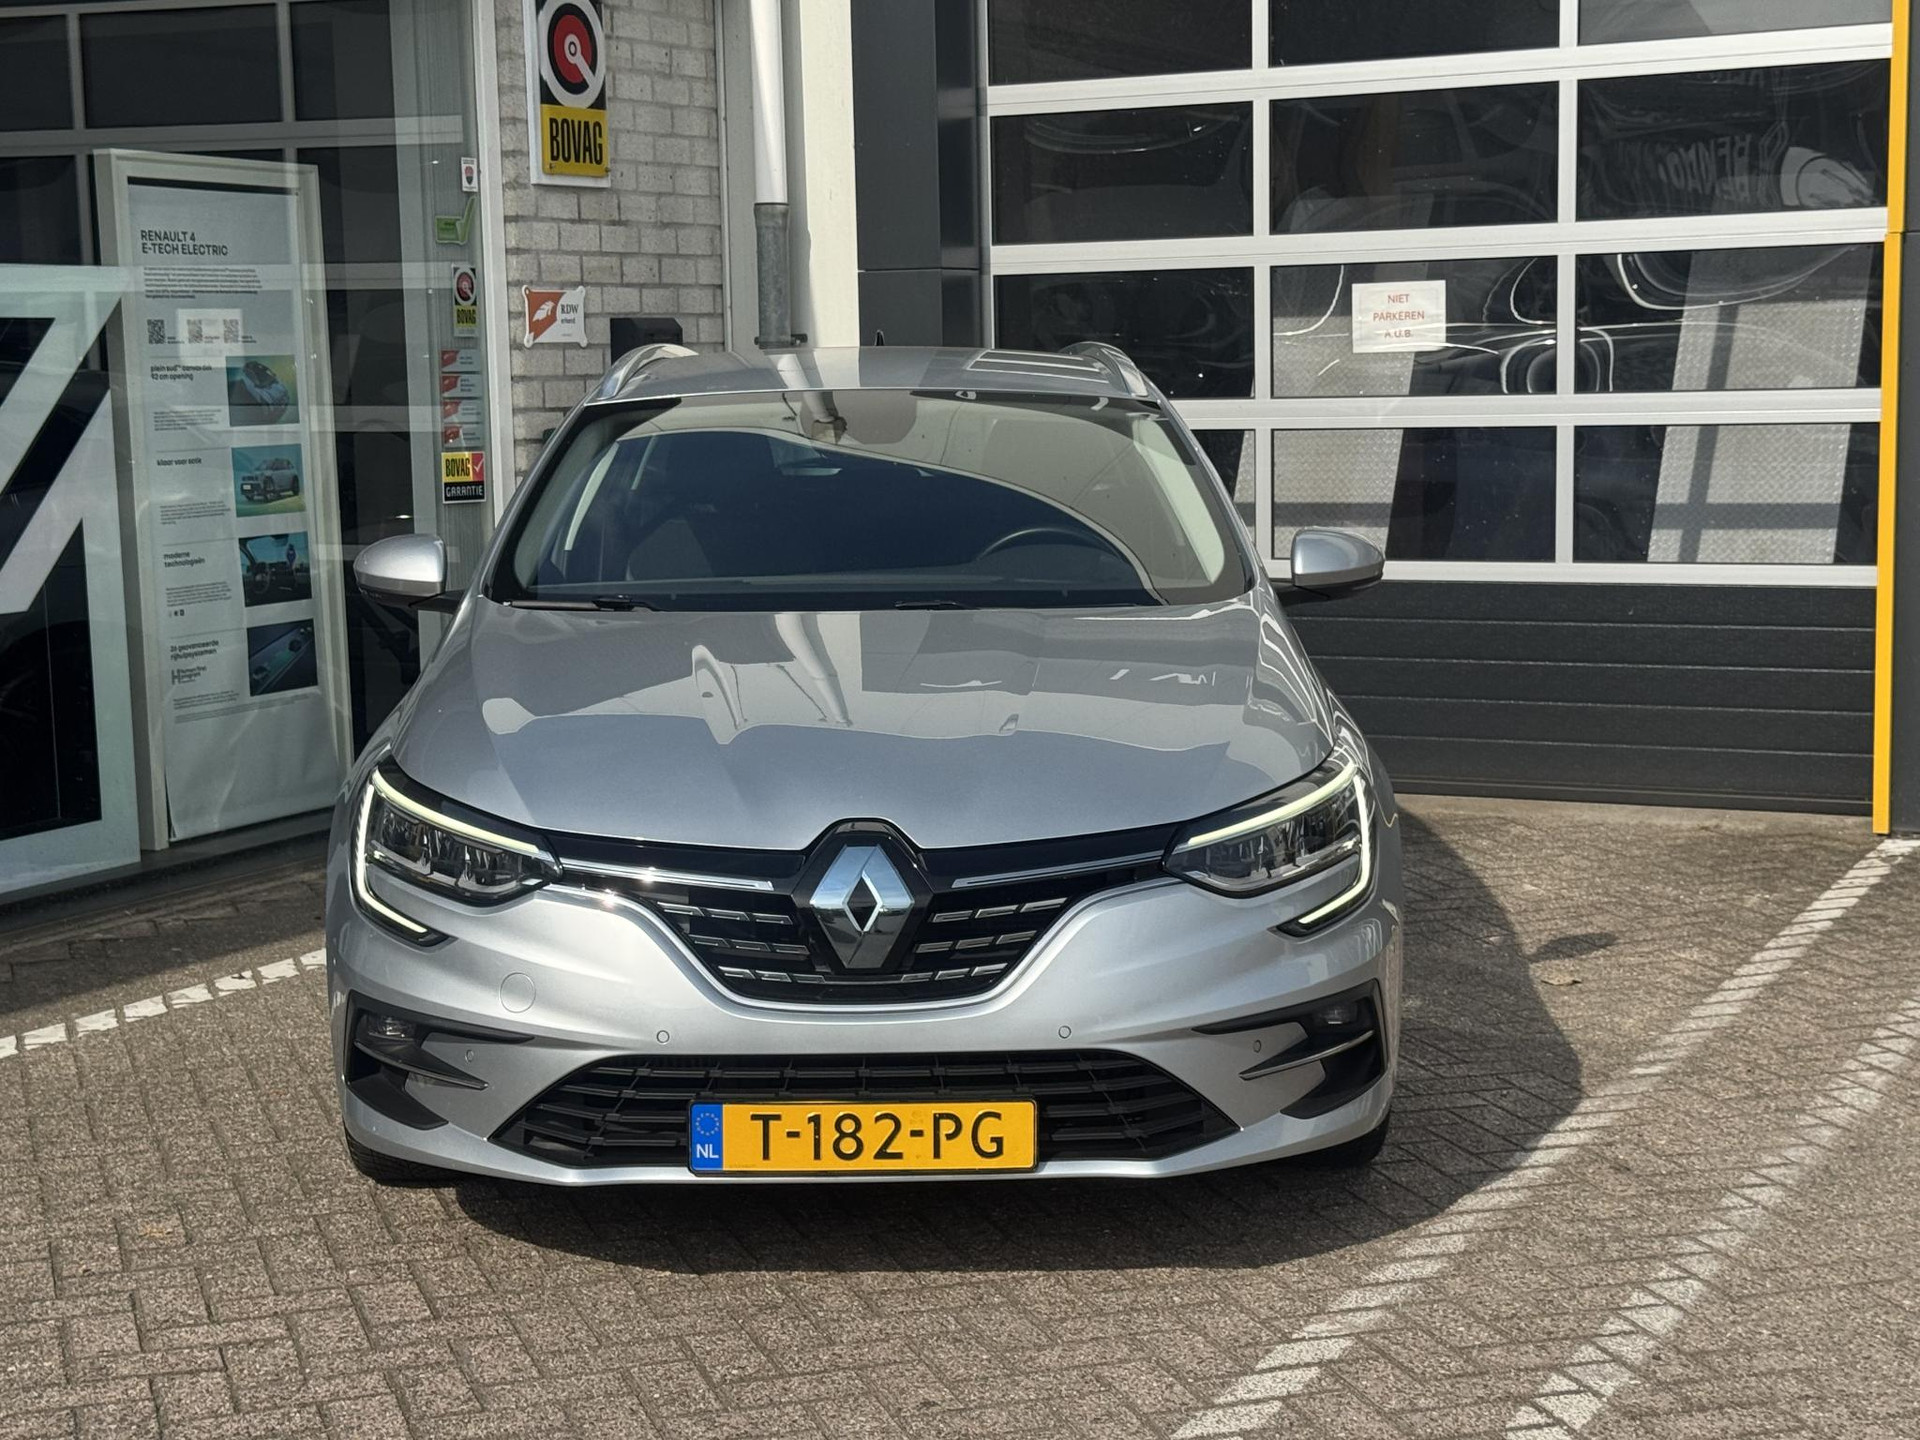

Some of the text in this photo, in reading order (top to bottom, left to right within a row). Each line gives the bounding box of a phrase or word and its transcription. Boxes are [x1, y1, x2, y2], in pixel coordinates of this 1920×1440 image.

[549, 117, 604, 166] BOVAG
[140, 229, 196, 243] RENAULT 4
[141, 243, 228, 257] E-TECH ELECTRIC
[1387, 293, 1410, 304] NIET
[560, 304, 579, 315] RDW
[1373, 310, 1425, 322] PARKEREN
[456, 309, 477, 325] BOVAG
[445, 457, 471, 478] BOVAG
[446, 485, 483, 498] GARANTIE
[696, 1110, 1005, 1161] NL T-182-PG
